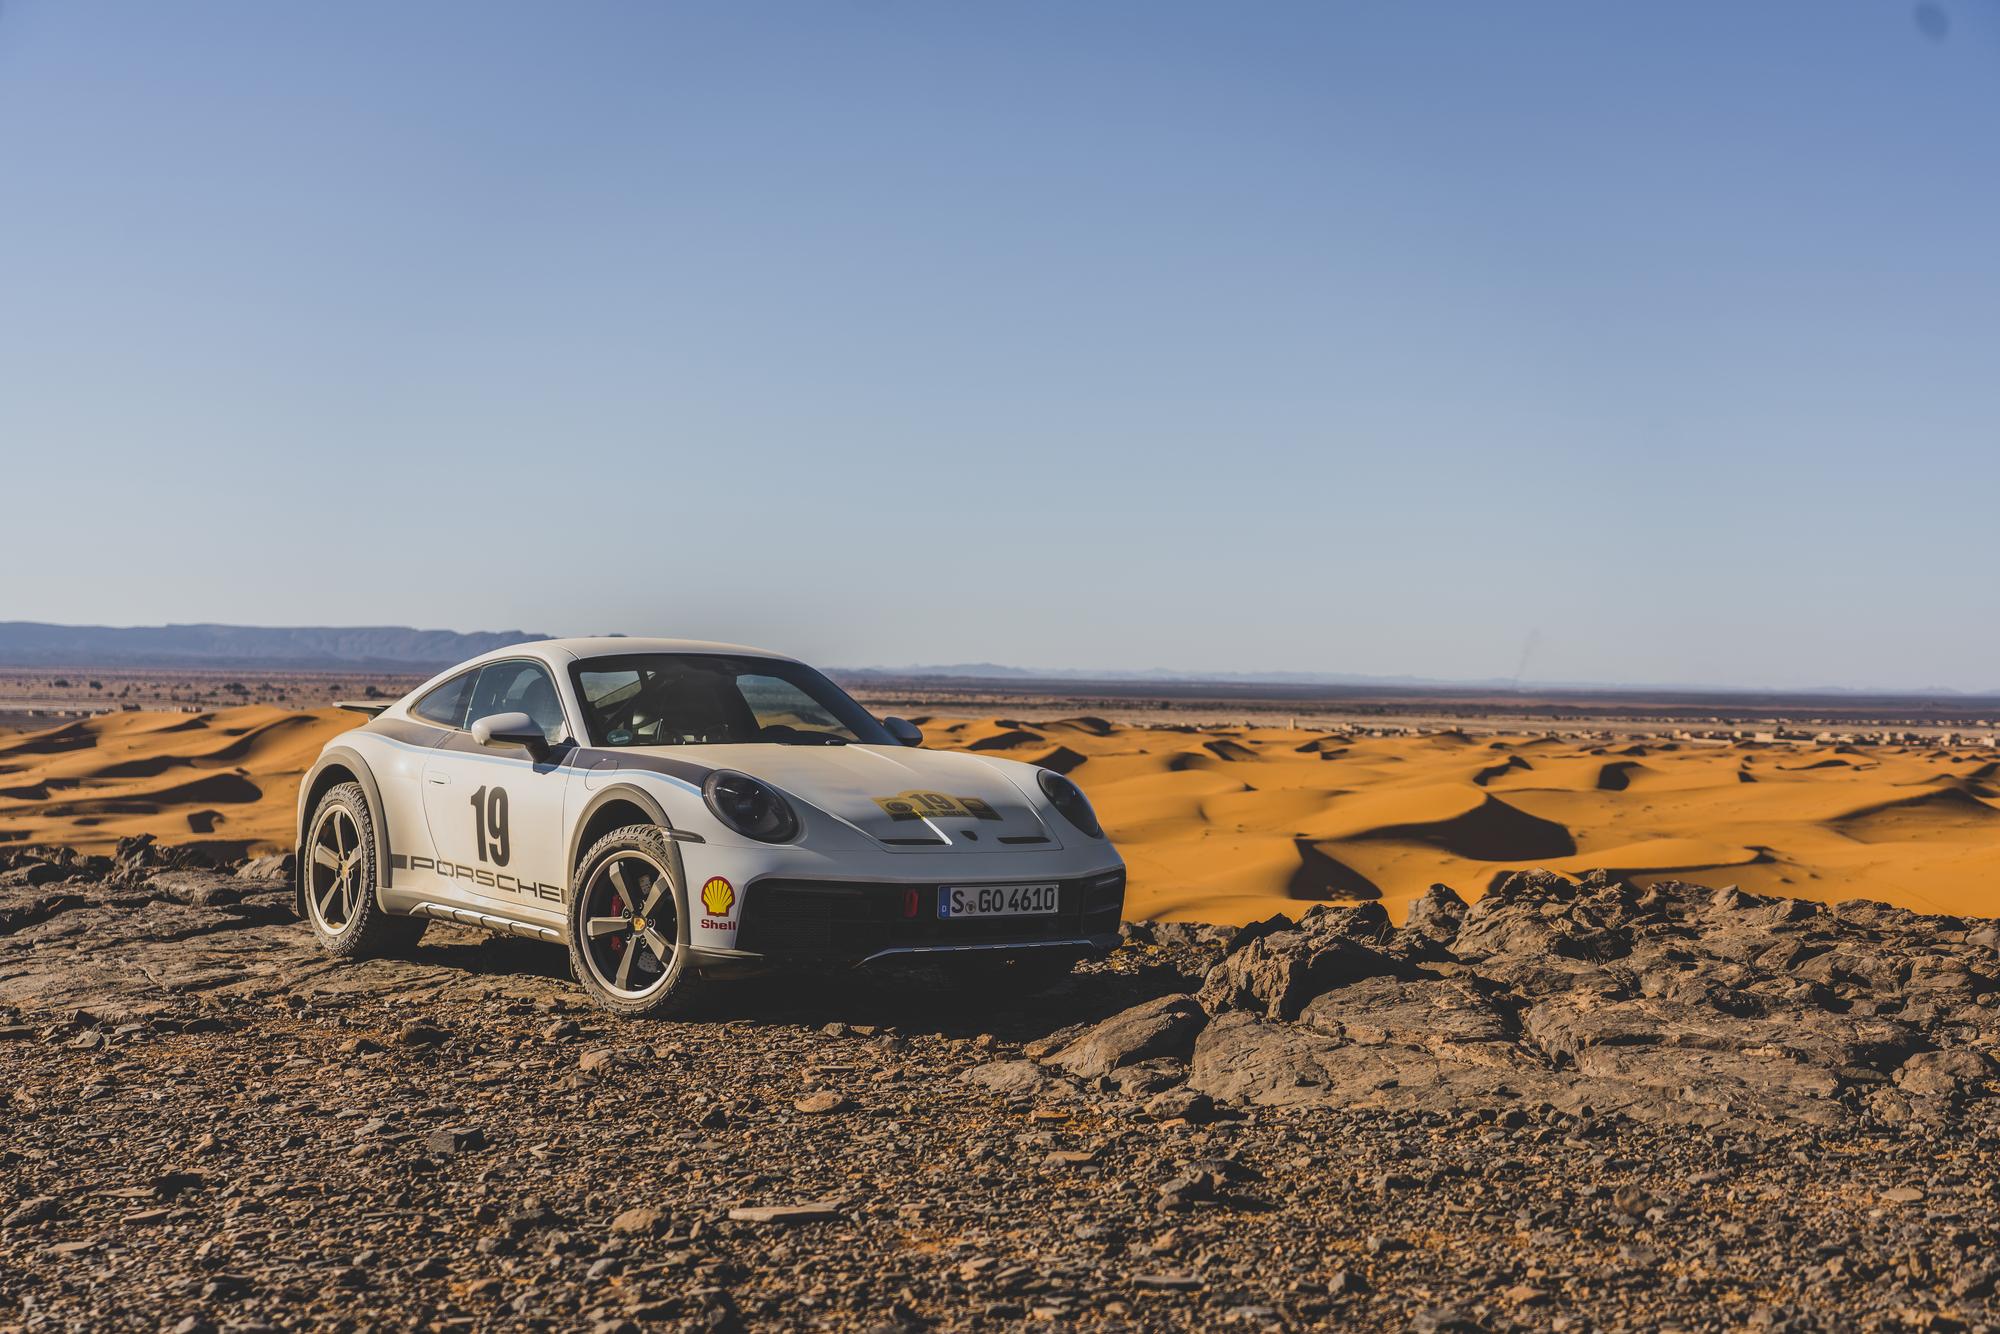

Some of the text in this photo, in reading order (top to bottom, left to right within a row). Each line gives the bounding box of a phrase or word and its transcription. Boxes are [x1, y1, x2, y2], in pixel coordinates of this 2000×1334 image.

[908, 793, 956, 810] 19
[470, 785, 510, 867] 19
[410, 855, 561, 903] PORSCHE
[951, 888, 1055, 913] S GO 4610
[701, 919, 736, 930] Shell
